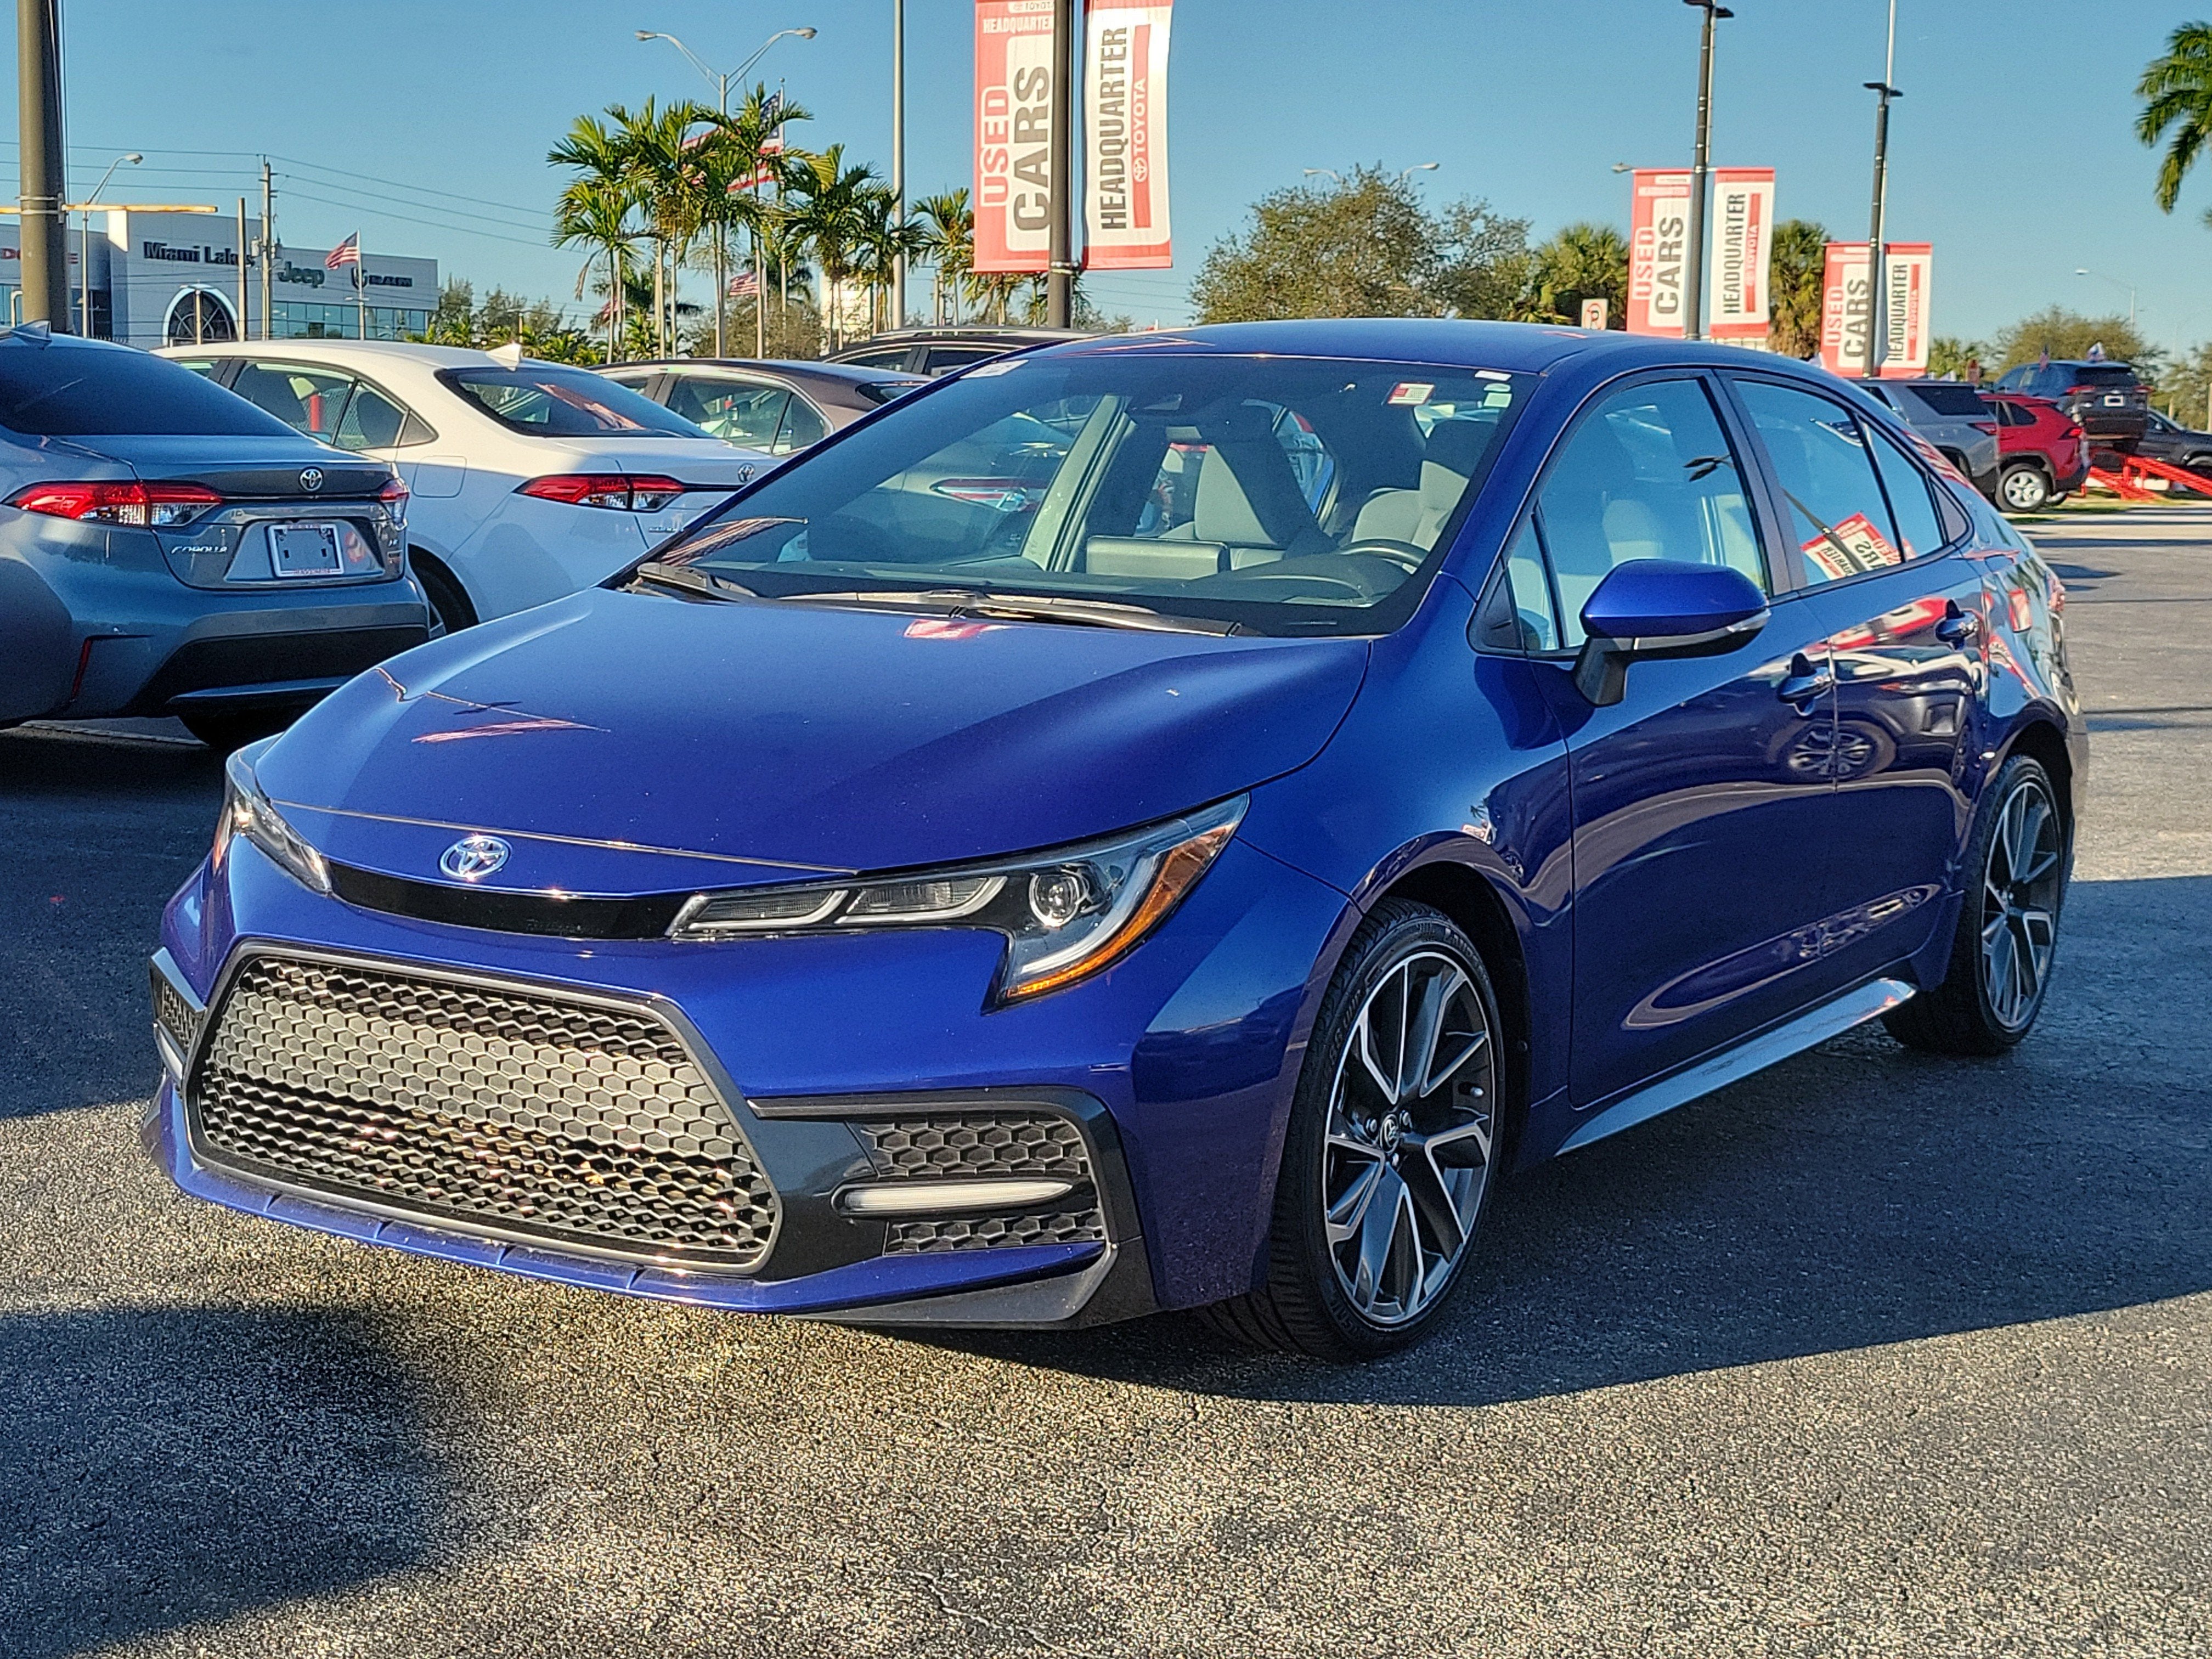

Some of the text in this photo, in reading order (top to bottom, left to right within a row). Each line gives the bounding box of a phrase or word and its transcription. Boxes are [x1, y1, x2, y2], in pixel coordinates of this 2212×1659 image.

[1025, 2, 1054, 10] TOYOT
[983, 87, 1009, 205] USED
[1014, 66, 1050, 231] CARS
[1099, 27, 1128, 229] HEADQUARTER
[1133, 78, 1146, 156] TOYOTA
[143, 241, 200, 262] Miami
[278, 261, 325, 288] Jeep
[1635, 229, 1655, 297] USED
[1655, 217, 1684, 314] CARS
[1723, 193, 1746, 314] HEADQUARTER
[1827, 289, 1843, 343] USED
[1844, 279, 1868, 357] CARS
[1887, 263, 1908, 361] HEADQUARTER
